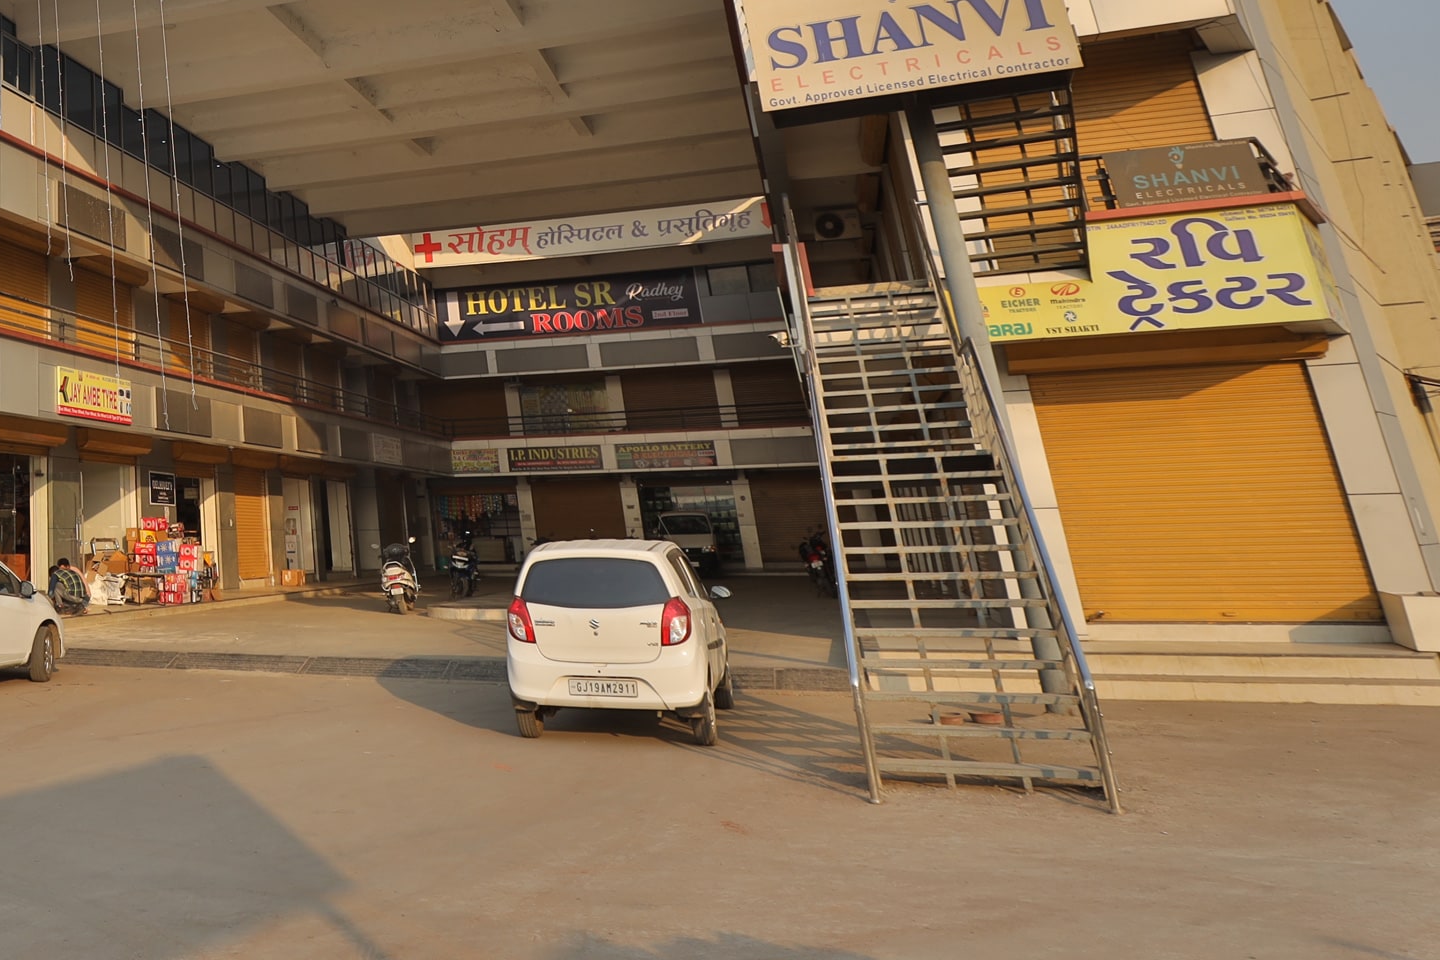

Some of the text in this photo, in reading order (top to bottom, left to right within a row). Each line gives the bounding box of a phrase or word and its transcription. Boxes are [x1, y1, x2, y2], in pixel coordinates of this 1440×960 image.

[771, 36, 1062, 92] ELECTRICALS
[769, 56, 1071, 108] Govt. Approved Licensed Electrical Contractor
[1132, 165, 1241, 190] SHANVI
[1135, 182, 1247, 200] ELECTRICALS
[447, 225, 532, 255] सोहम्
[536, 223, 624, 249] होस्पिटल
[631, 219, 649, 238] &
[1128, 217, 1266, 271] રવિ
[465, 281, 684, 316] HOTEL SR Radhey
[1001, 297, 1041, 309] EICHER
[530, 305, 645, 334] ROOMS
[69, 381, 117, 410] JAY AMBE TYRE
[528, 446, 599, 460] INDUSTRIES
[619, 442, 712, 453] APOLLO BATTERY
[576, 682, 636, 694] GJ19AM2911
